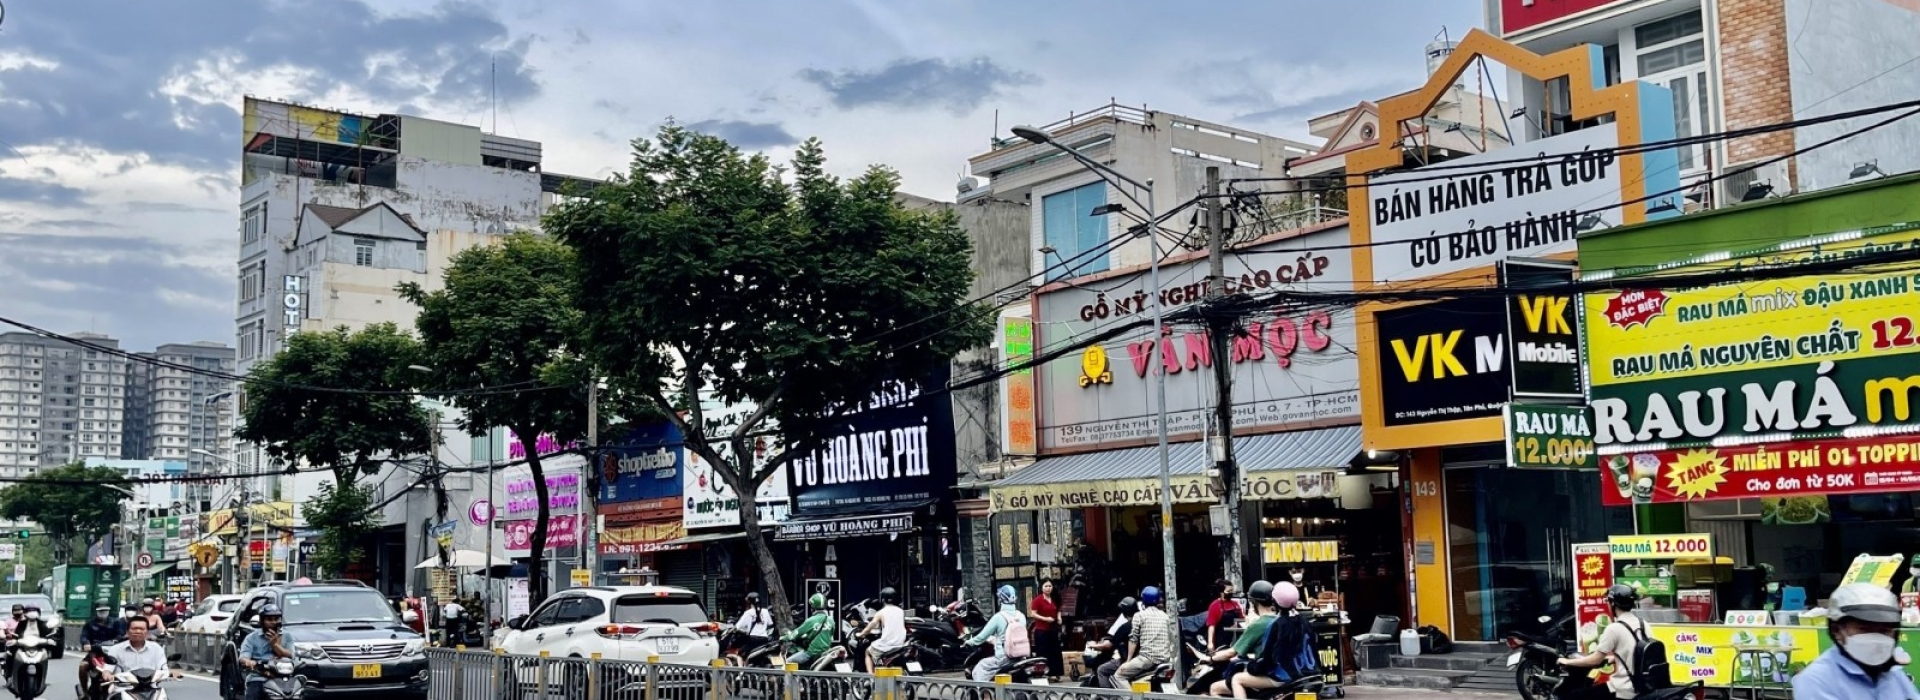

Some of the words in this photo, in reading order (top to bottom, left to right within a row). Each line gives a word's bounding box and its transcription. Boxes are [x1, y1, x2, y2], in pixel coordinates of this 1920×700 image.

[1374, 188, 1421, 226] BÁN
[1428, 173, 1495, 215] HÀNG
[1502, 151, 1552, 199] TRẢ
[1560, 144, 1615, 187] GÓP
[1410, 230, 1441, 268] CÓ
[1450, 219, 1497, 262] BẢO
[1505, 209, 1578, 252] HÀNH
[1080, 292, 1109, 322] GỖ
[1114, 290, 1148, 317] MỸ
[1223, 269, 1272, 294] CAO
[1276, 252, 1329, 283] CẤP
[1678, 303, 1713, 322] RAU
[1718, 292, 1748, 317] MÁ
[1751, 287, 1798, 313] mix
[1802, 281, 1844, 308] ĐẬU
[1849, 276, 1908, 299] XANH
[1518, 294, 1572, 335] VK
[1613, 305, 1636, 322] ĐẶC
[1637, 296, 1661, 314] BIỆT
[1127, 325, 1213, 379] VÂN
[1231, 306, 1332, 370] MỘC
[1390, 329, 1469, 383] VK
[1475, 333, 1503, 374] M
[1518, 341, 1577, 364] Mobile
[1612, 355, 1655, 377] RAU
[1659, 345, 1694, 371] MÁ
[1700, 335, 1790, 366] NGUYÊN
[1796, 319, 1860, 354] CHẤT
[1591, 387, 1727, 445] RAU
[1740, 360, 1858, 433] MÁ
[1061, 425, 1083, 437] 139
[1086, 420, 1130, 434] NGUYỄN
[1152, 415, 1183, 428] TẬP
[1285, 403, 1292, 411] 7
[1515, 411, 1557, 434] RAU
[1560, 409, 1591, 437] MÁ
[822, 423, 889, 485] HOÀNG
[1677, 459, 1717, 486] TẶNG
[1733, 445, 1781, 472] MIỄN
[1788, 445, 1821, 468] PHÍ
[1827, 448, 1850, 467] 01
[1010, 490, 1028, 508] GỖ
[1034, 491, 1054, 507] MỸ
[1060, 488, 1098, 507] NGHỆ
[1103, 490, 1129, 503] CAO
[1133, 483, 1162, 502] CẤP
[1246, 476, 1292, 500] ỘC
[1414, 481, 1436, 496] 143
[1746, 478, 1771, 491] Cho
[1775, 476, 1801, 490] đơn
[1806, 474, 1823, 489] từ
[1826, 473, 1854, 488] 50K
[840, 518, 878, 531] HOÀNG
[882, 517, 904, 528] PHI
[1612, 543, 1632, 553] RAU
[1634, 541, 1652, 553] MÁ
[1655, 538, 1707, 553] 12.000
[1676, 632, 1698, 643] CÀNG
[1696, 646, 1713, 655] MIX
[1674, 653, 1696, 664] CÀNG
[1691, 668, 1715, 676] NGON
